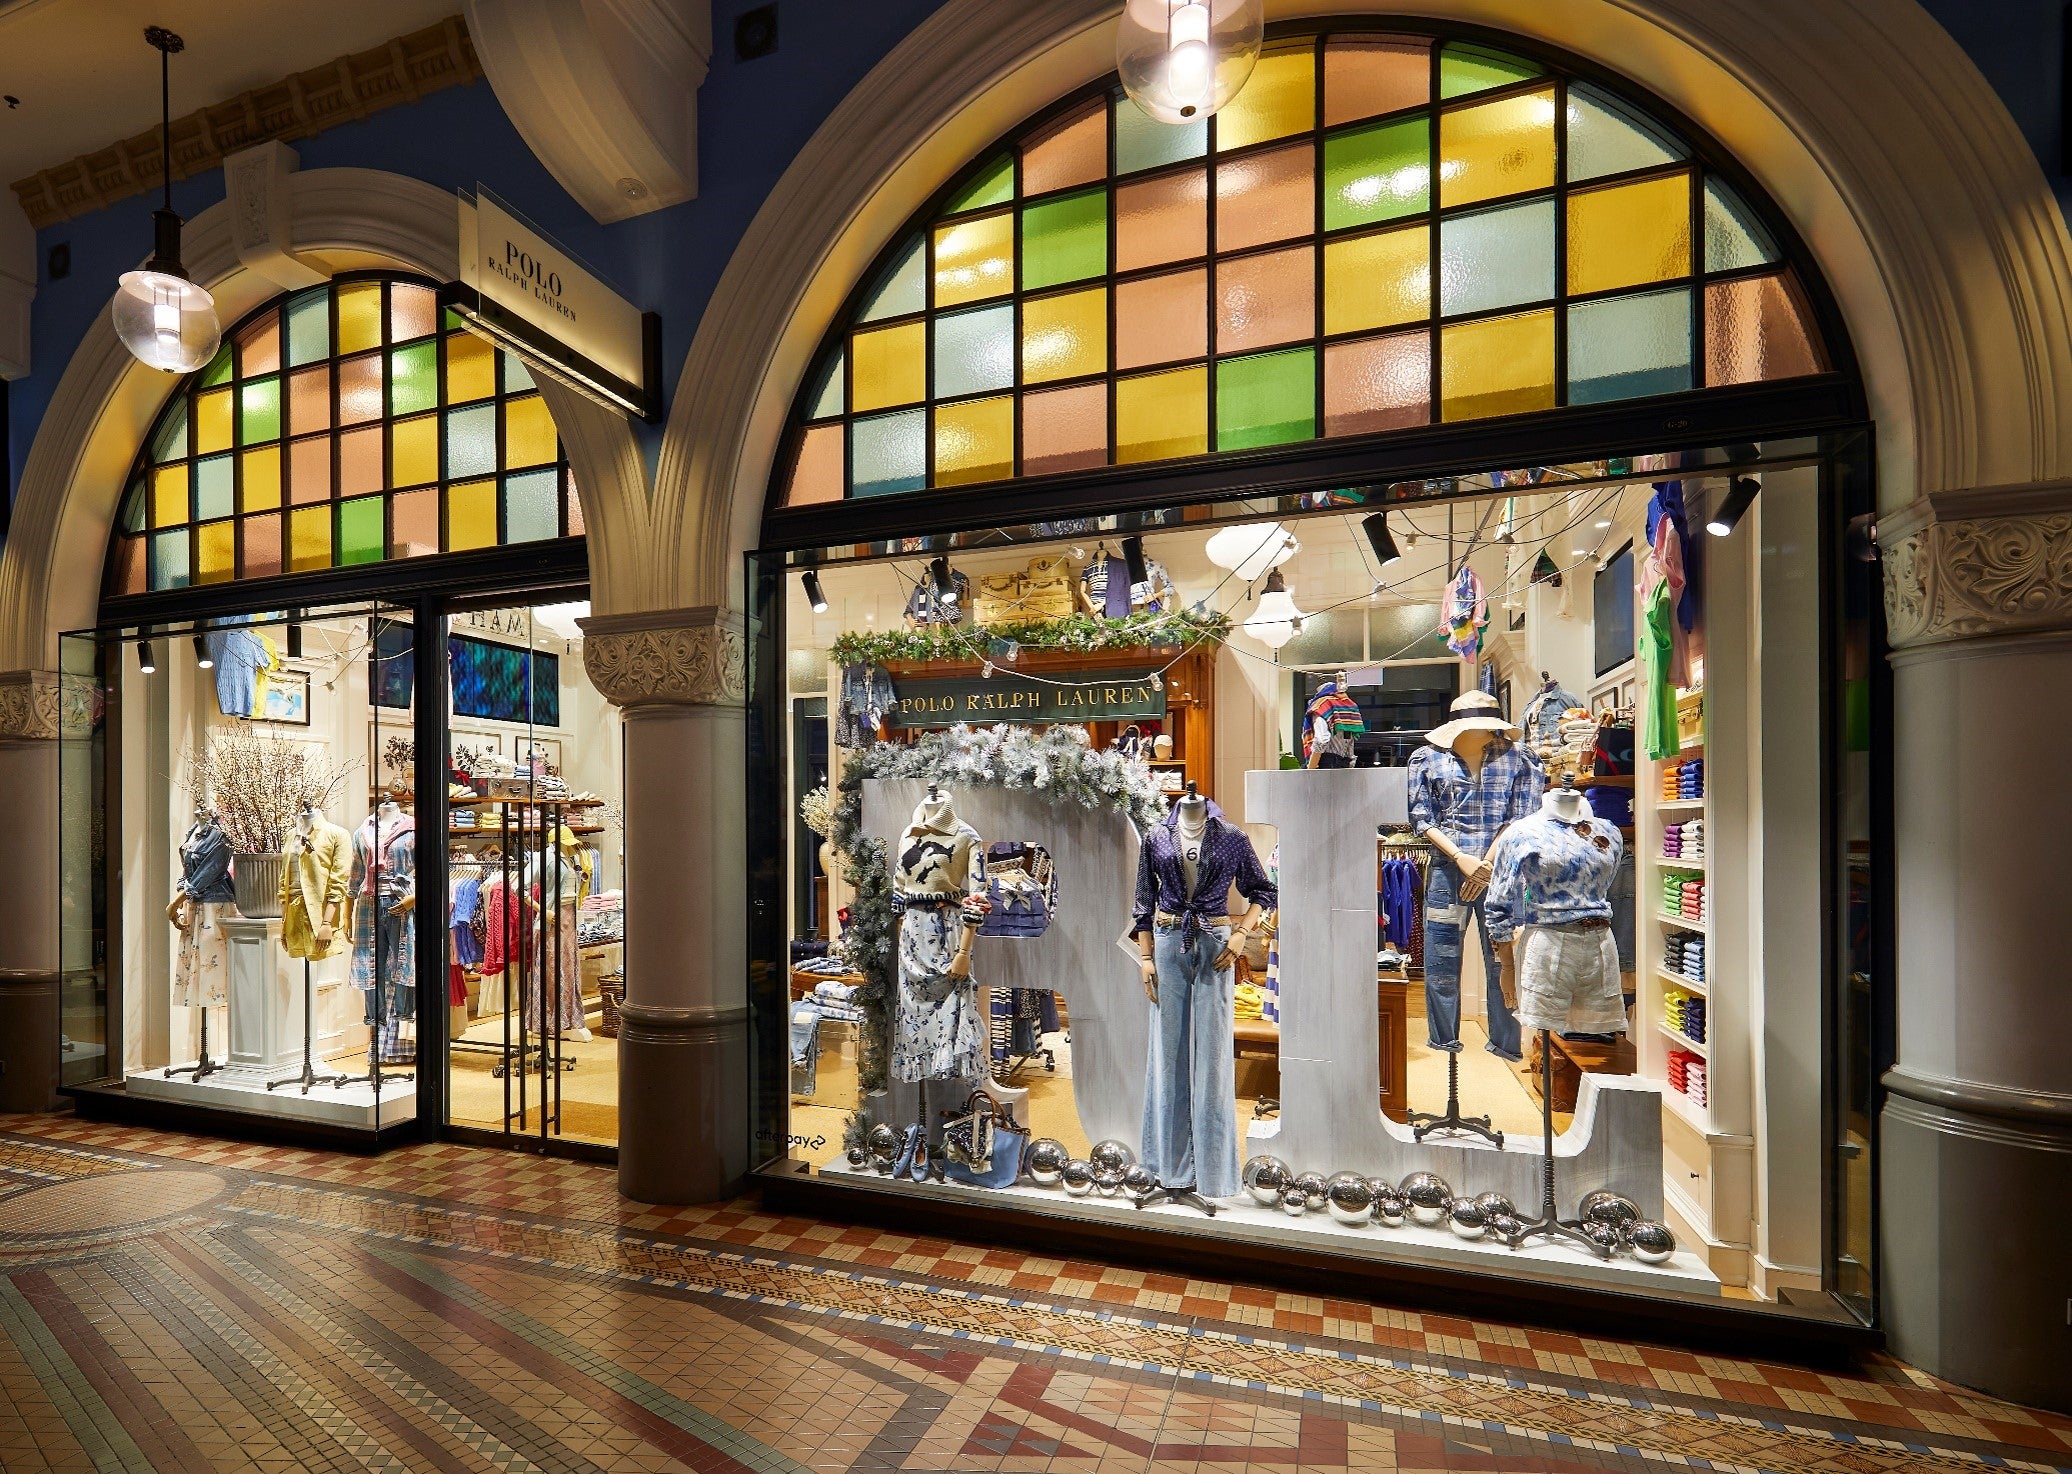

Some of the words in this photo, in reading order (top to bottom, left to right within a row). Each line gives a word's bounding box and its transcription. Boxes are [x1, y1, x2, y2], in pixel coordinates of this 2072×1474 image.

[488, 256, 527, 291] RALPH
[534, 286, 576, 322] LAUREN
[505, 240, 562, 297] POLO
[900, 695, 955, 713] POLO
[966, 691, 1041, 710] RALPH
[1056, 686, 1151, 706] LAUREN
[755, 1129, 811, 1149] afterpay
